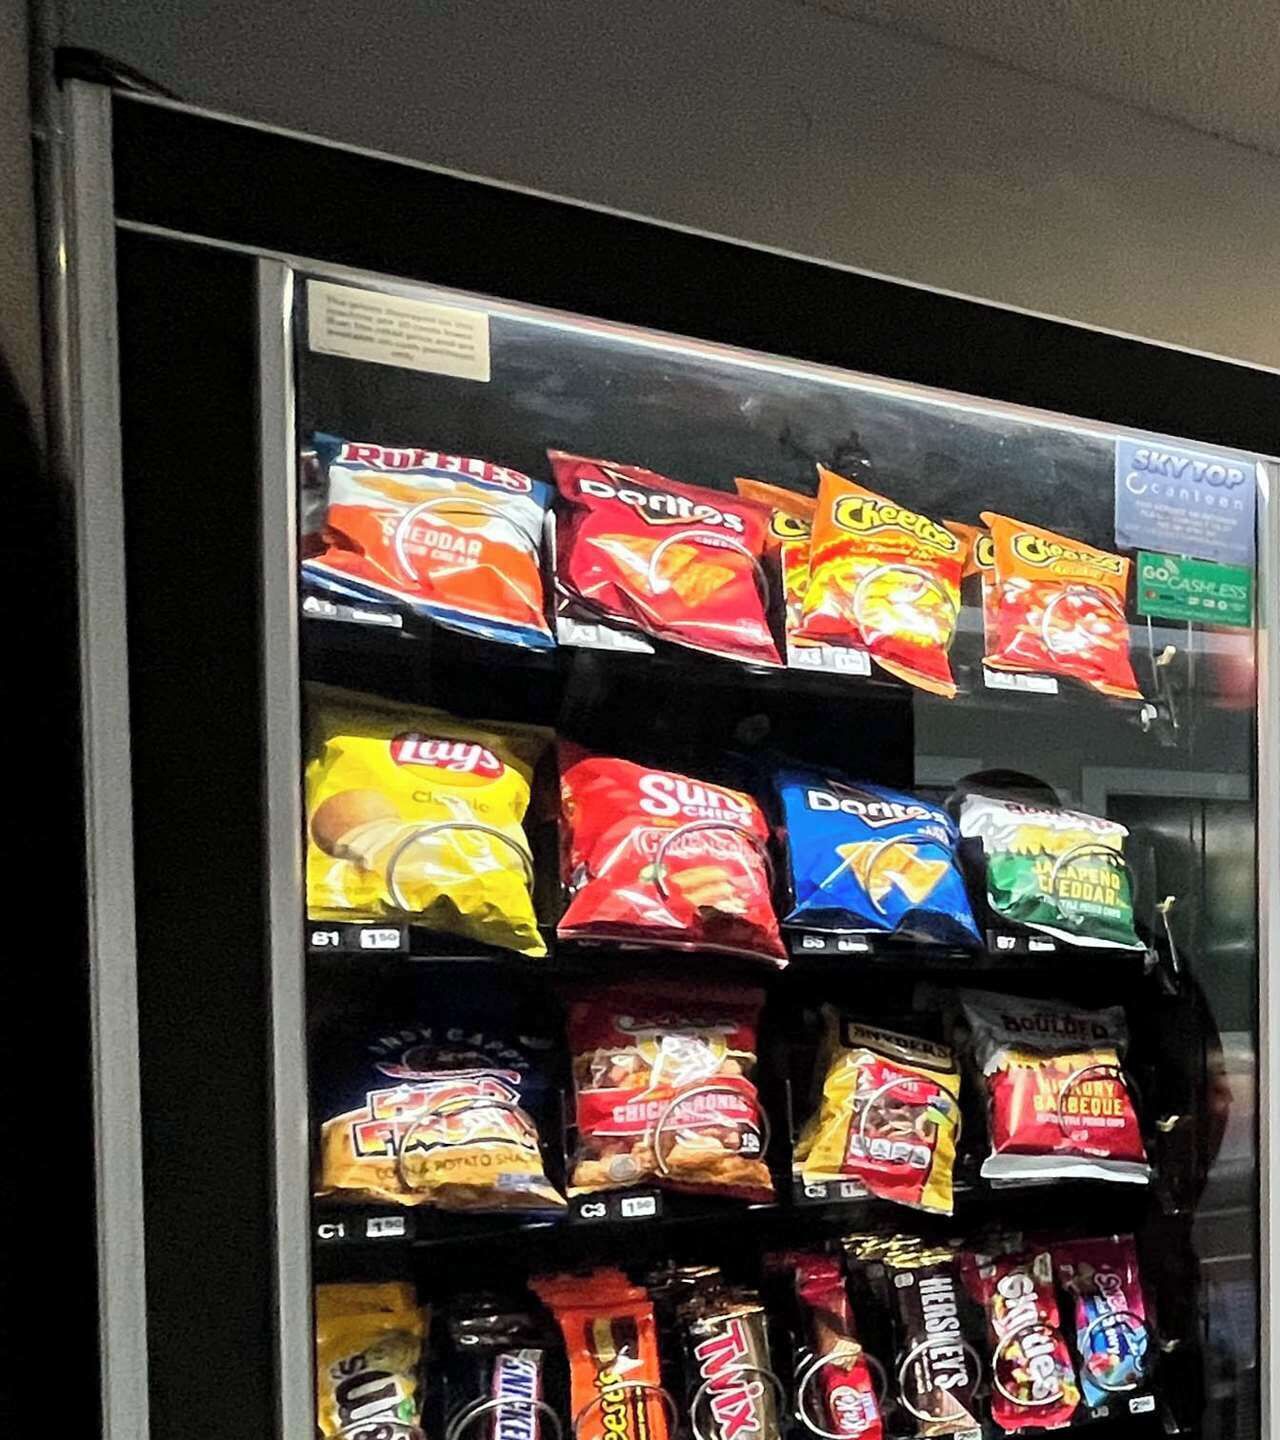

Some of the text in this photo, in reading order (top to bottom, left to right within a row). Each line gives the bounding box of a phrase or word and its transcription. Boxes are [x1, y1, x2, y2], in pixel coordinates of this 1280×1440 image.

[1132, 449, 1246, 489] SKYTOP
[579, 478, 745, 533] Doritos
[835, 495, 956, 551] Cheetos
[412, 790, 489, 813] Clic
[638, 774, 752, 816] Sun
[682, 804, 753, 827] CHIPS
[807, 789, 950, 827] Doritos
[311, 931, 340, 946] B1
[1034, 1095, 1125, 1116] BABEQUE
[580, 1202, 607, 1217] C3
[317, 1223, 345, 1239] C1
